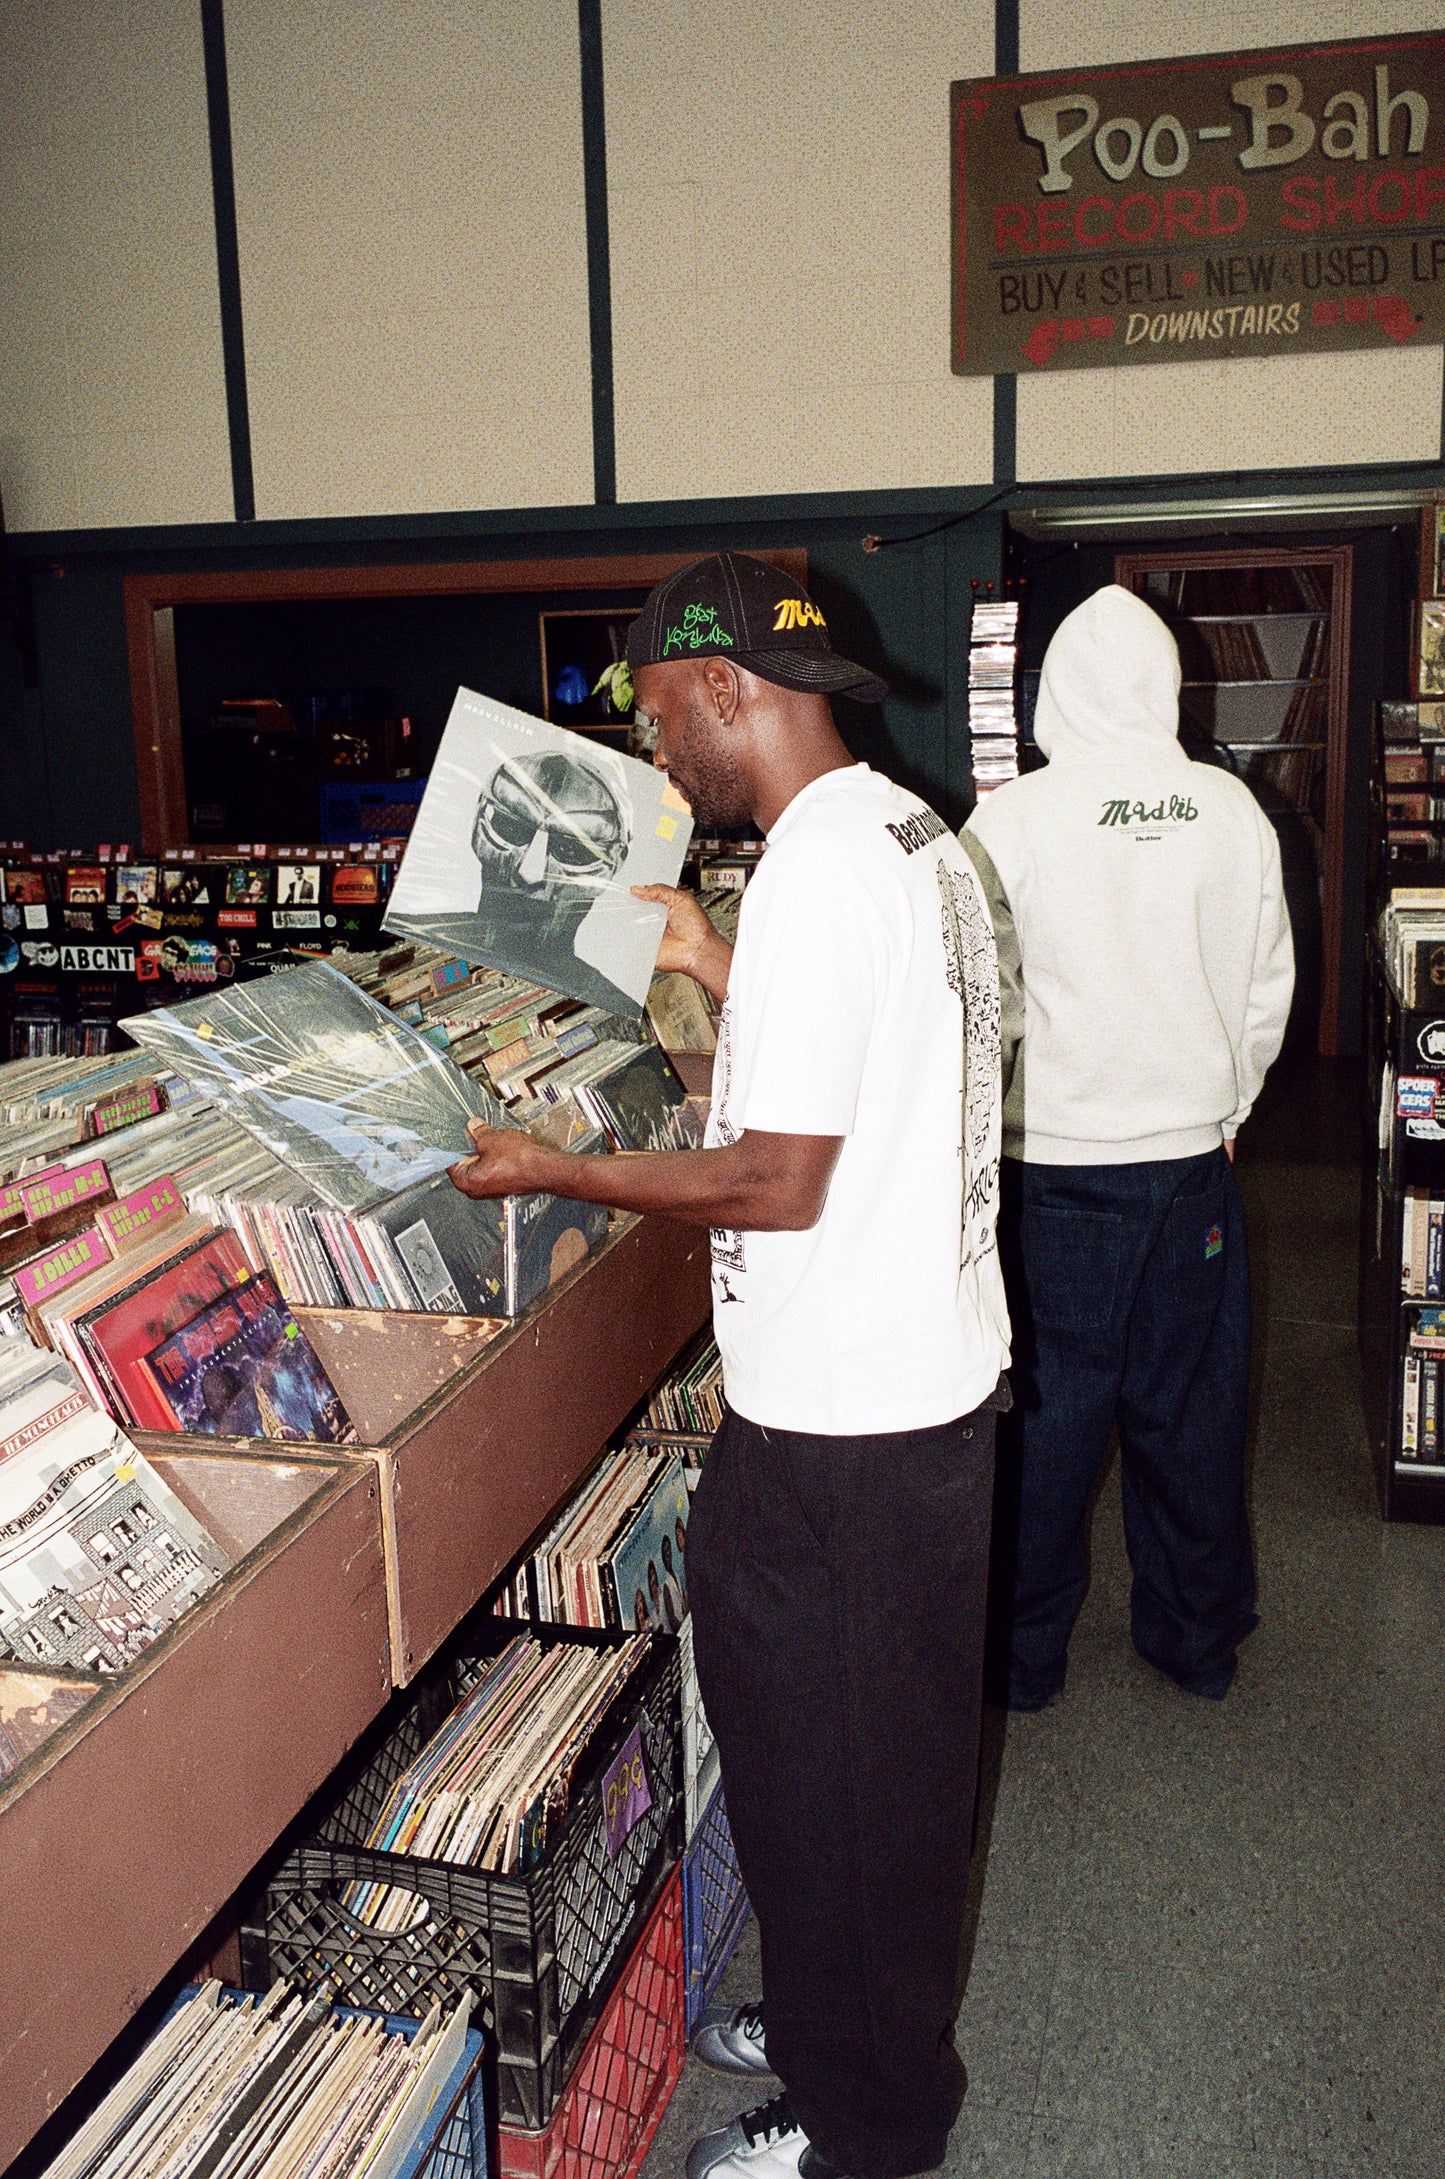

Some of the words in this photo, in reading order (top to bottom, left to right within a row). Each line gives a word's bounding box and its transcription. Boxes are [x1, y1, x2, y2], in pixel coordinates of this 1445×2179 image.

[1019, 64, 1429, 193] Poo-Bah
[995, 184, 1248, 253] RECORD
[1000, 272, 1066, 315] BUY
[1100, 259, 1183, 306] SELL
[1205, 254, 1276, 298] NEW
[1303, 245, 1390, 291] USED
[1124, 302, 1300, 346] DOWNSTAIRS
[1098, 794, 1198, 826] Madlib
[63, 948, 133, 969] ABCNT
[299, 942, 322, 950] FLOYD
[32, 1267, 46, 1290] J
[43, 1240, 92, 1283] DILLA
[0, 1522, 17, 1540] HE
[15, 1500, 48, 1530] WORLD
[52, 1487, 62, 1497] A
[59, 1456, 97, 1489] GHETTO
